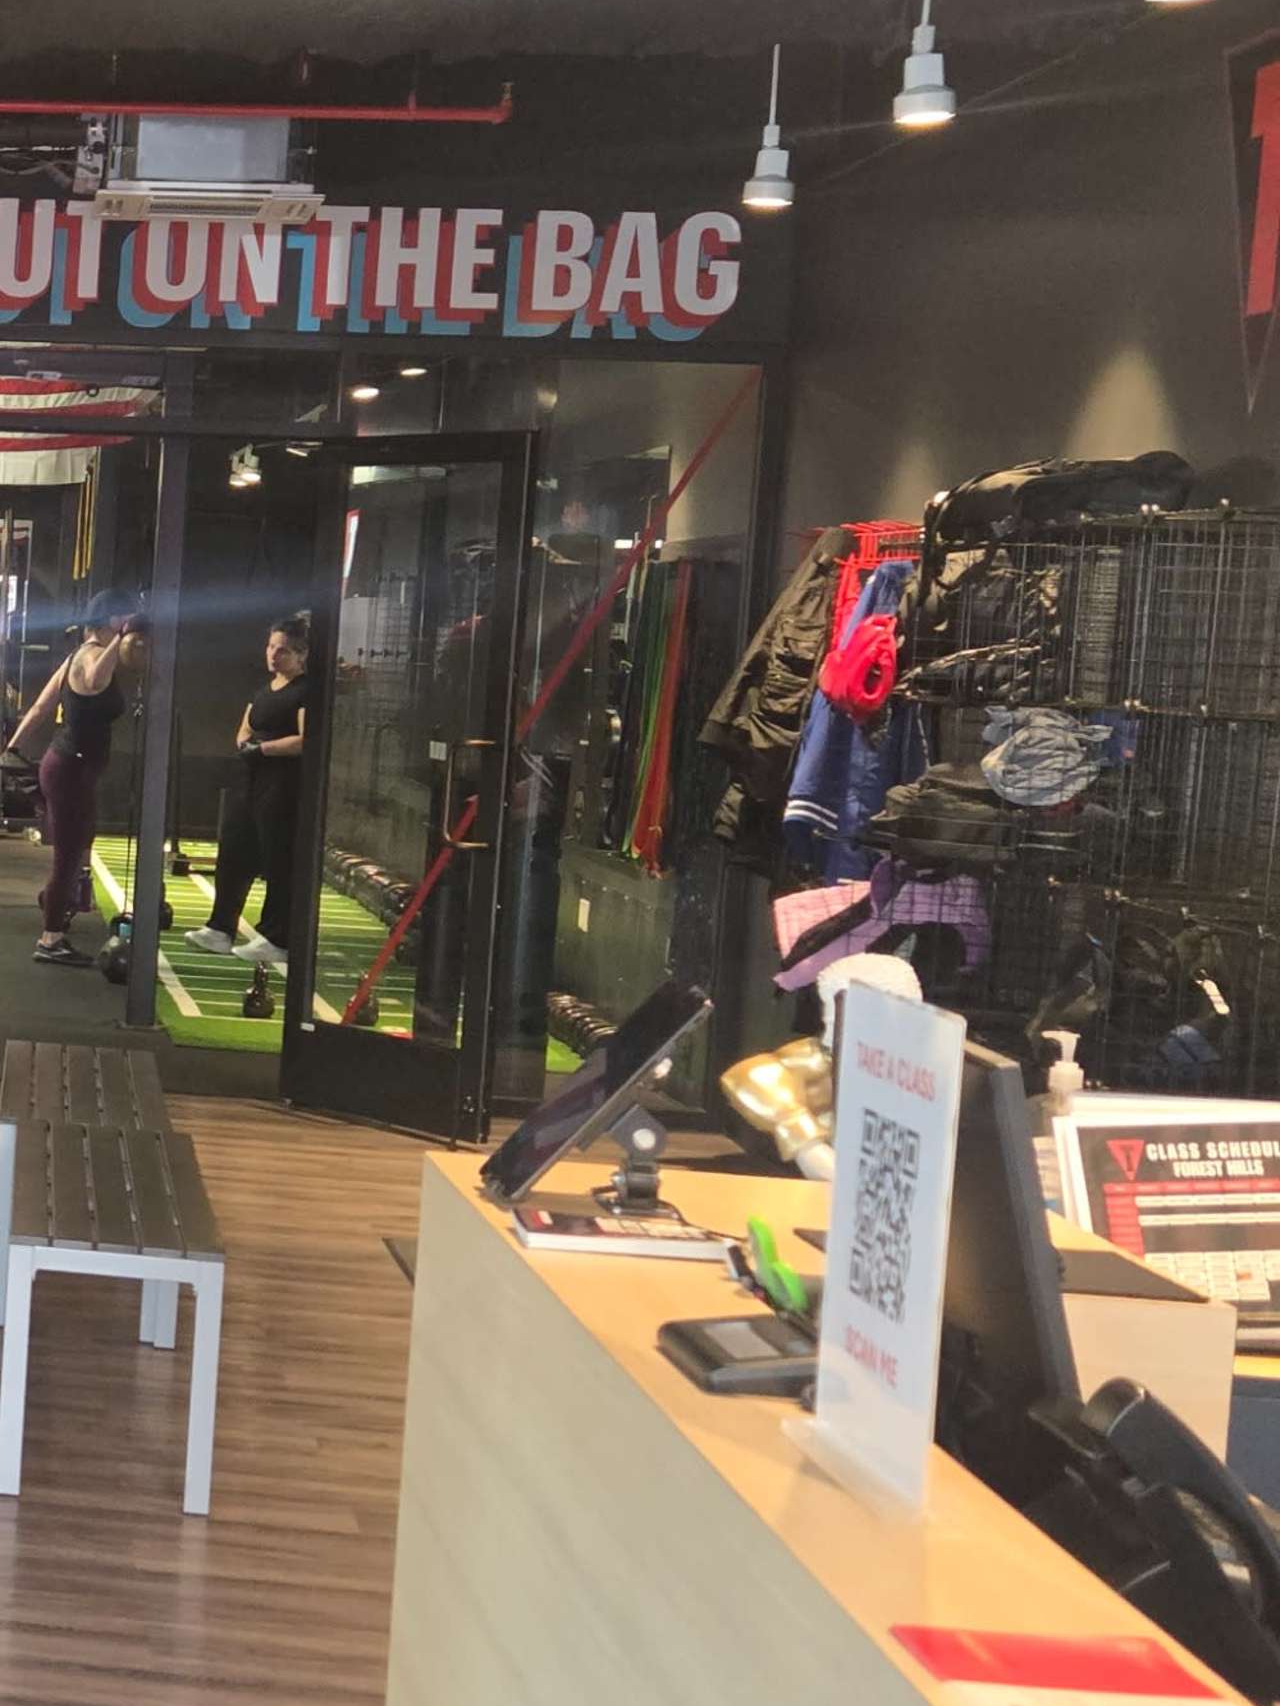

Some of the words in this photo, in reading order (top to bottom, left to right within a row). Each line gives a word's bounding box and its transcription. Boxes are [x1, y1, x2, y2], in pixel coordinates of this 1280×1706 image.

[314, 205, 503, 310] THE
[531, 210, 741, 315] BAG
[898, 1057, 936, 1103] CLASS
[1146, 1142, 1200, 1161] CLASS
[1173, 1159, 1223, 1178] FOREST
[1226, 1158, 1265, 1177] HILLS
